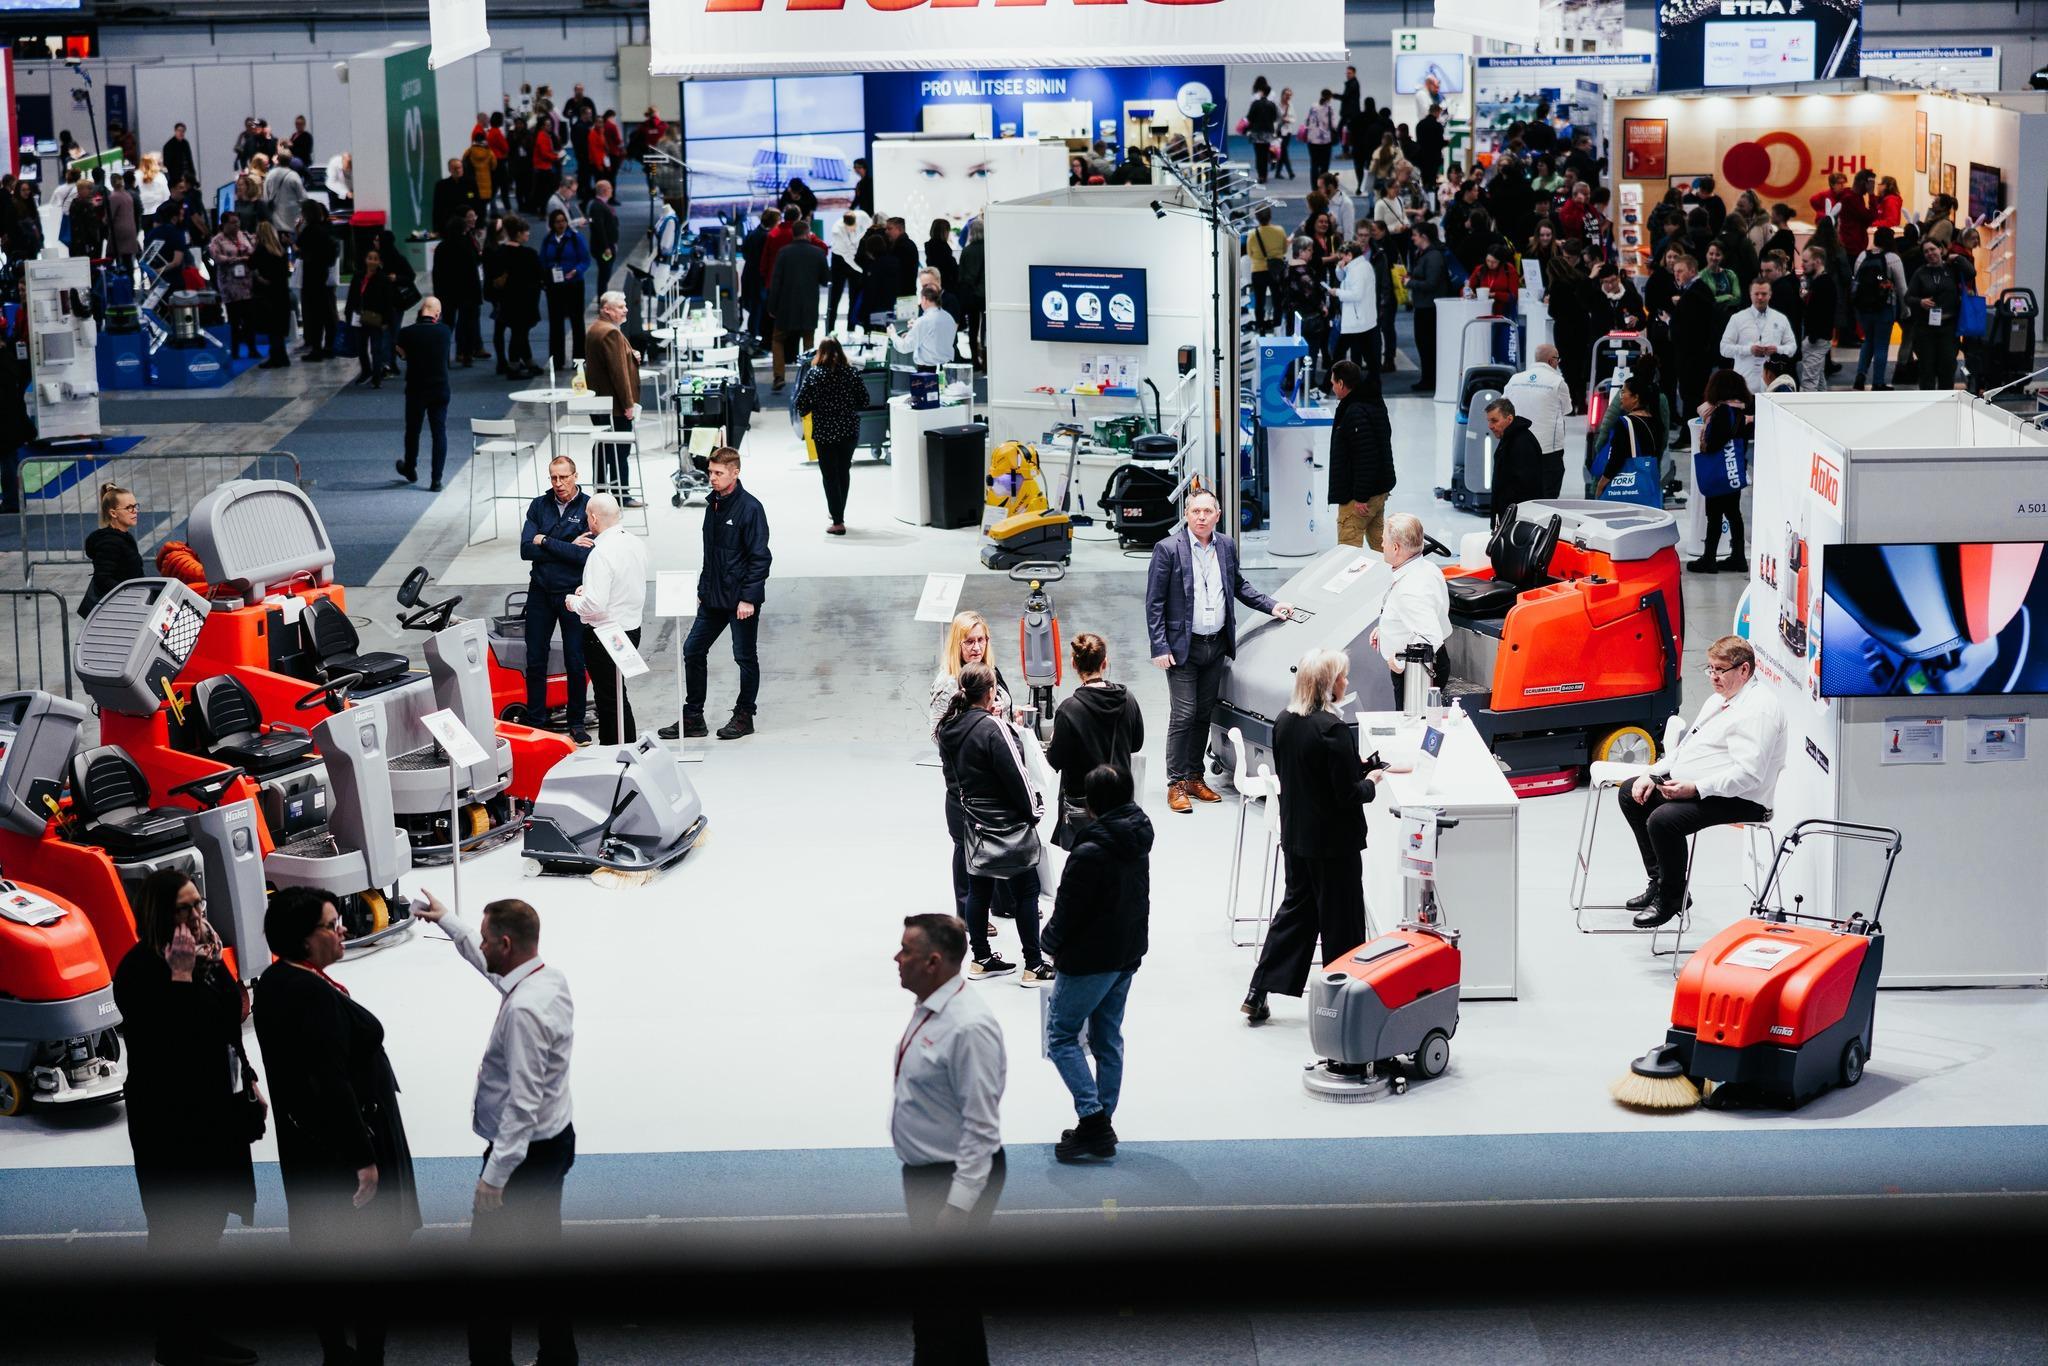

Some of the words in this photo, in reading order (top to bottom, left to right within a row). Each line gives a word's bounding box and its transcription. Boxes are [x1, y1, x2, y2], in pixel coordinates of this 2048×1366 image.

[1720, 0, 1786, 15] ETRA
[921, 80, 951, 96] PRO
[953, 79, 1024, 96] VALITSEE
[1025, 78, 1066, 95] SININ
[1821, 155, 1873, 175] JHL
[1612, 477, 1634, 485] TORK
[1810, 452, 1840, 506] Hako
[2017, 504, 2026, 513] A
[2028, 503, 2047, 513] 501
[226, 806, 248, 822] Hako
[98, 1000, 118, 1015] Hak
[1315, 1006, 1338, 1019] Hako
[1770, 1025, 1795, 1036] Hako
